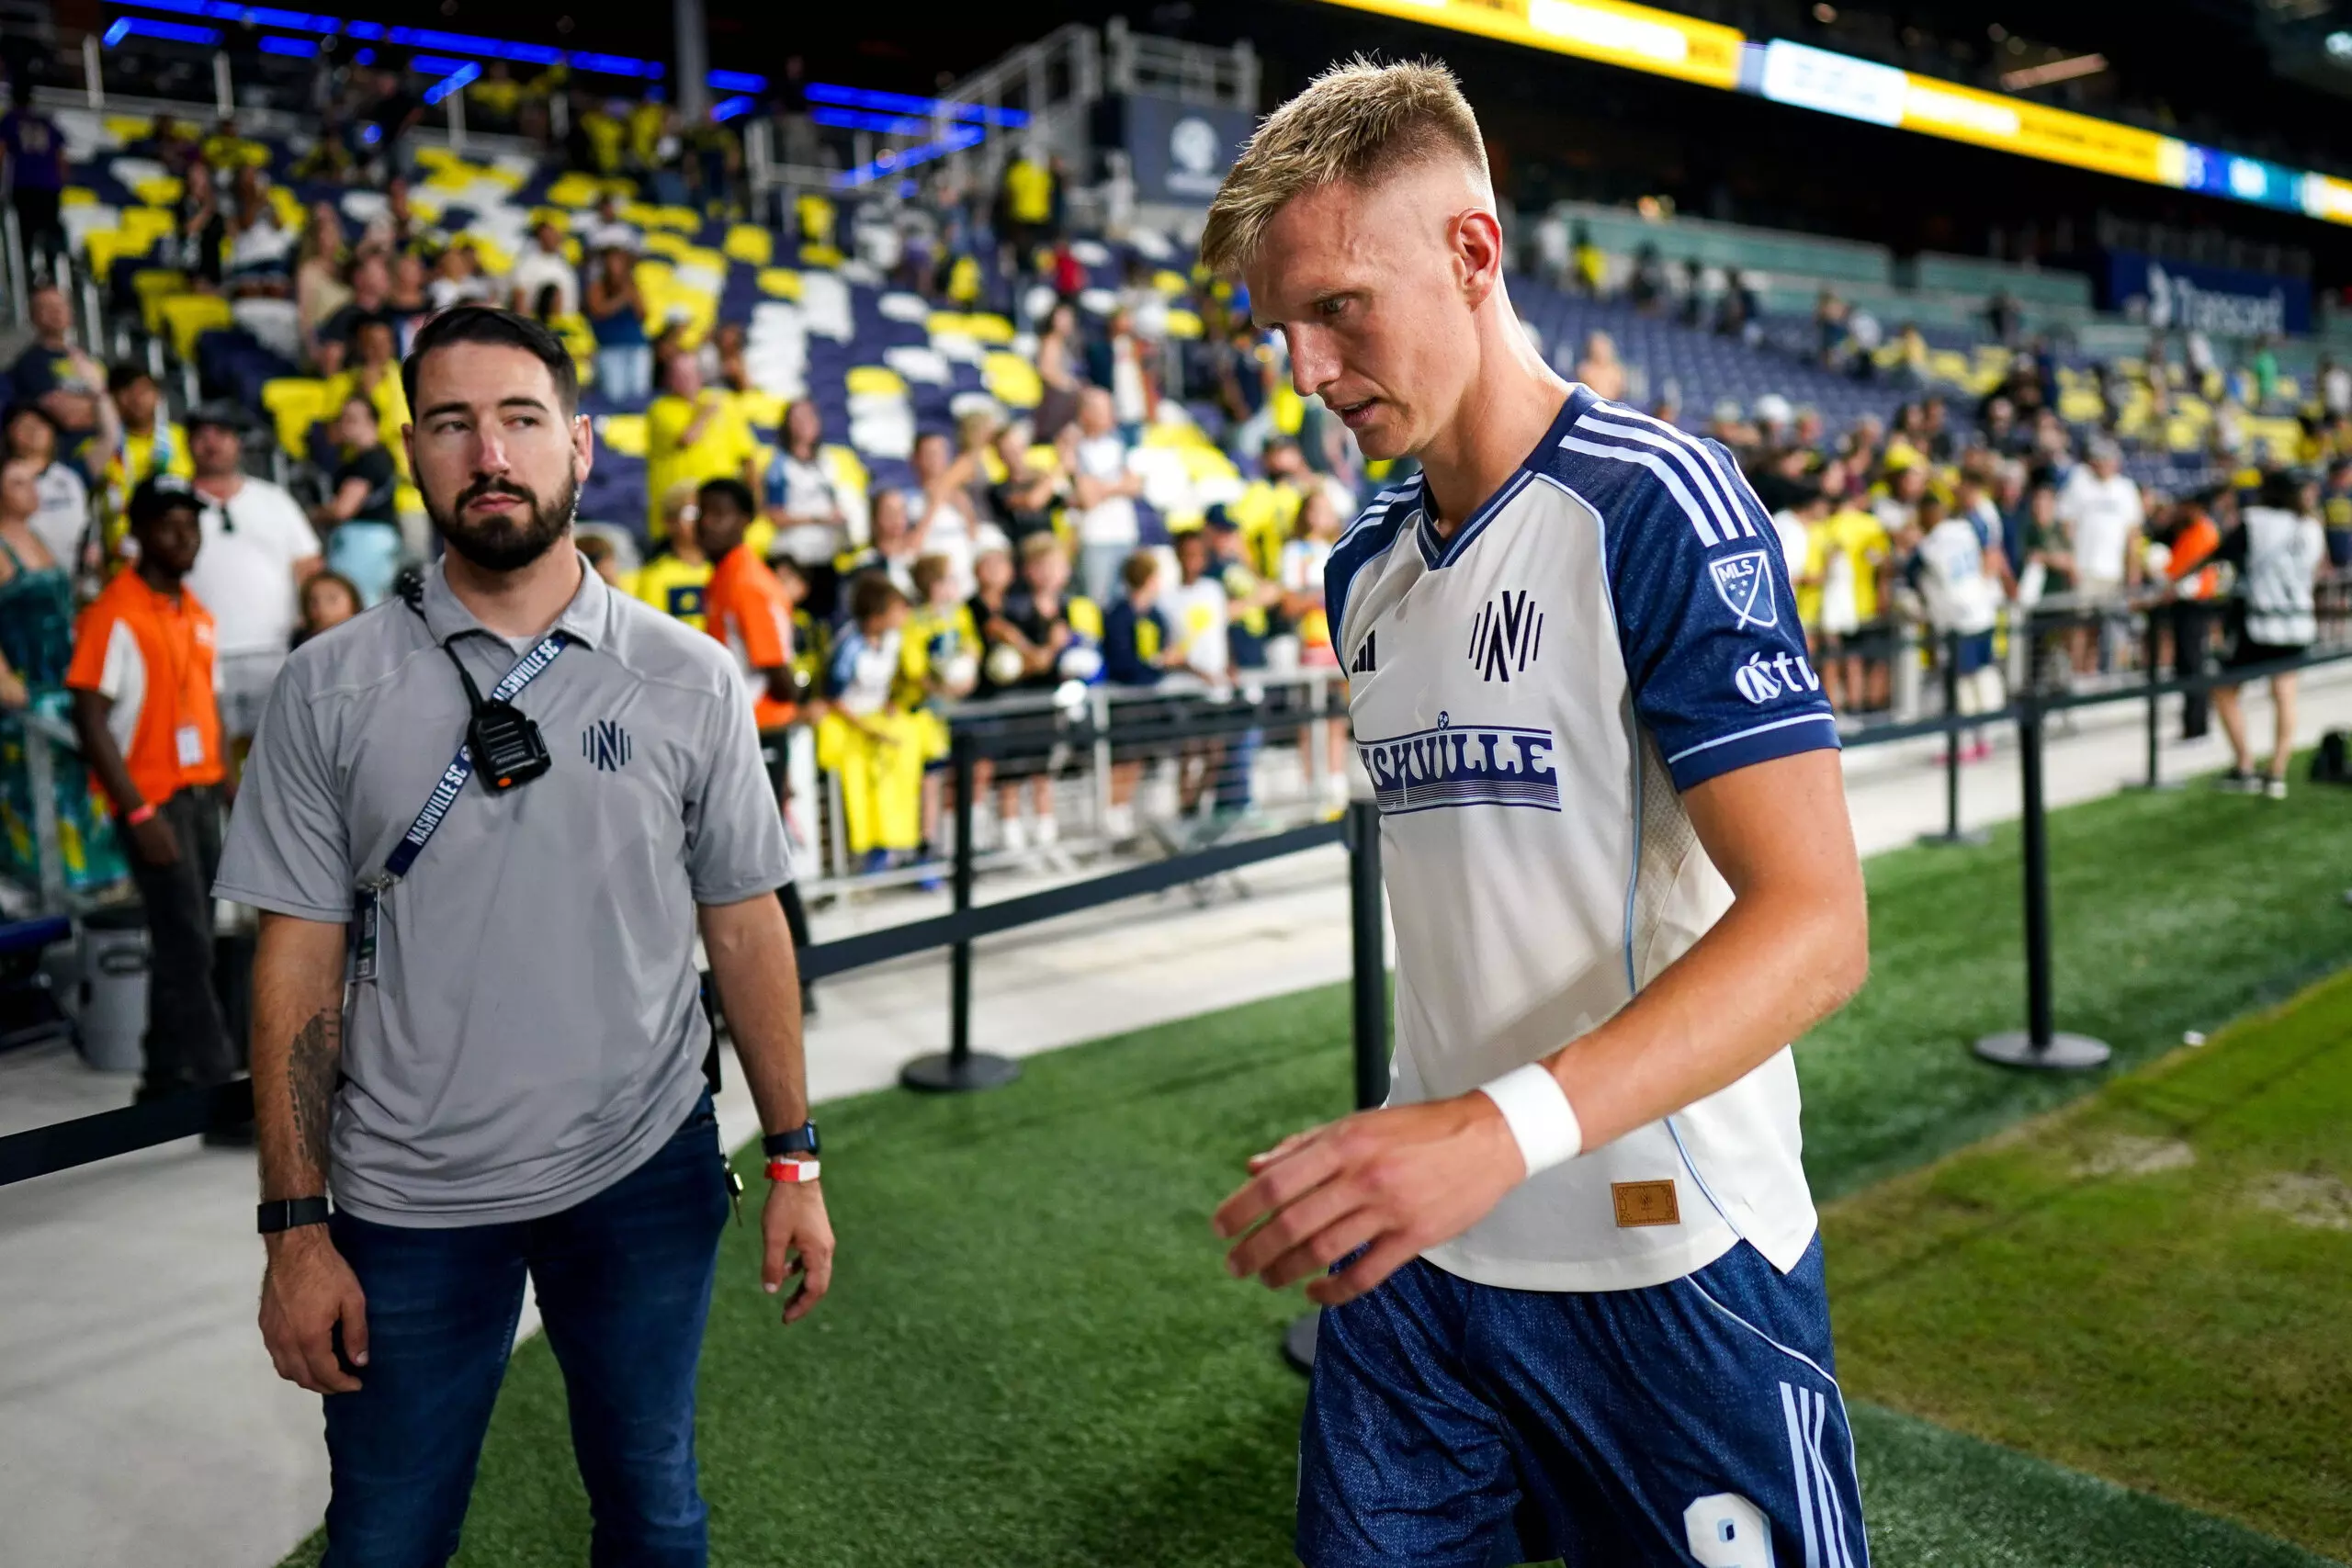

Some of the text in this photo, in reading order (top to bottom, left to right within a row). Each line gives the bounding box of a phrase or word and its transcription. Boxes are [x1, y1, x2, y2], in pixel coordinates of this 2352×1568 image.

[1716, 558, 1755, 582] MLS
[492, 638, 560, 702] ASHVILLE SC
[406, 764, 468, 846] NASHVILLE SC
